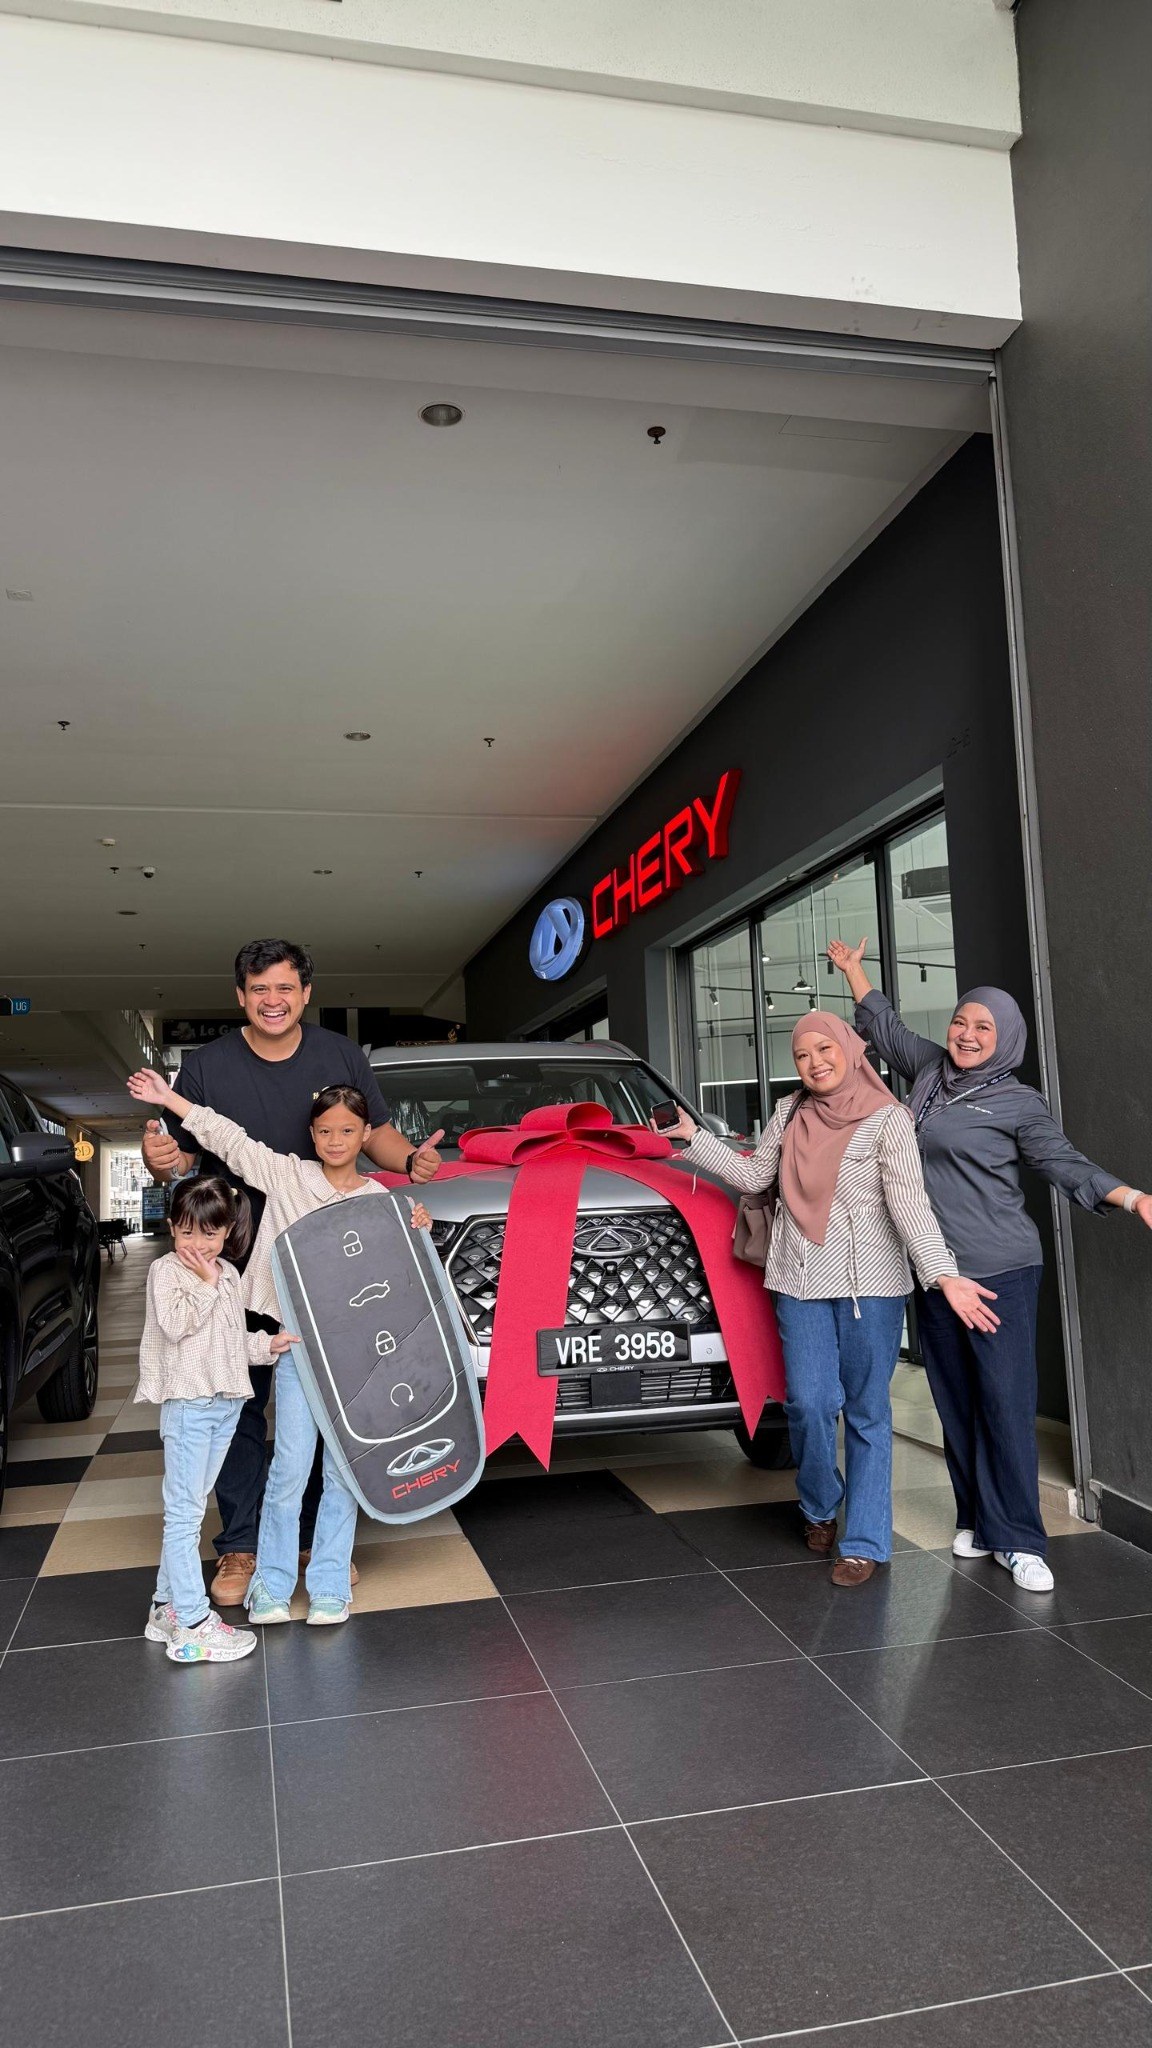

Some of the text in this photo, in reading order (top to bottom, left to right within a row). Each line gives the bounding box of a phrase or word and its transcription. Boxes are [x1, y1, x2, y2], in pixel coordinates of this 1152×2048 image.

[592, 768, 742, 939] CHERY
[15, 1001, 27, 1011] UG
[199, 1024, 215, 1036] Le
[555, 1330, 676, 1365] VRE 3958
[391, 1458, 461, 1499] CHERY
